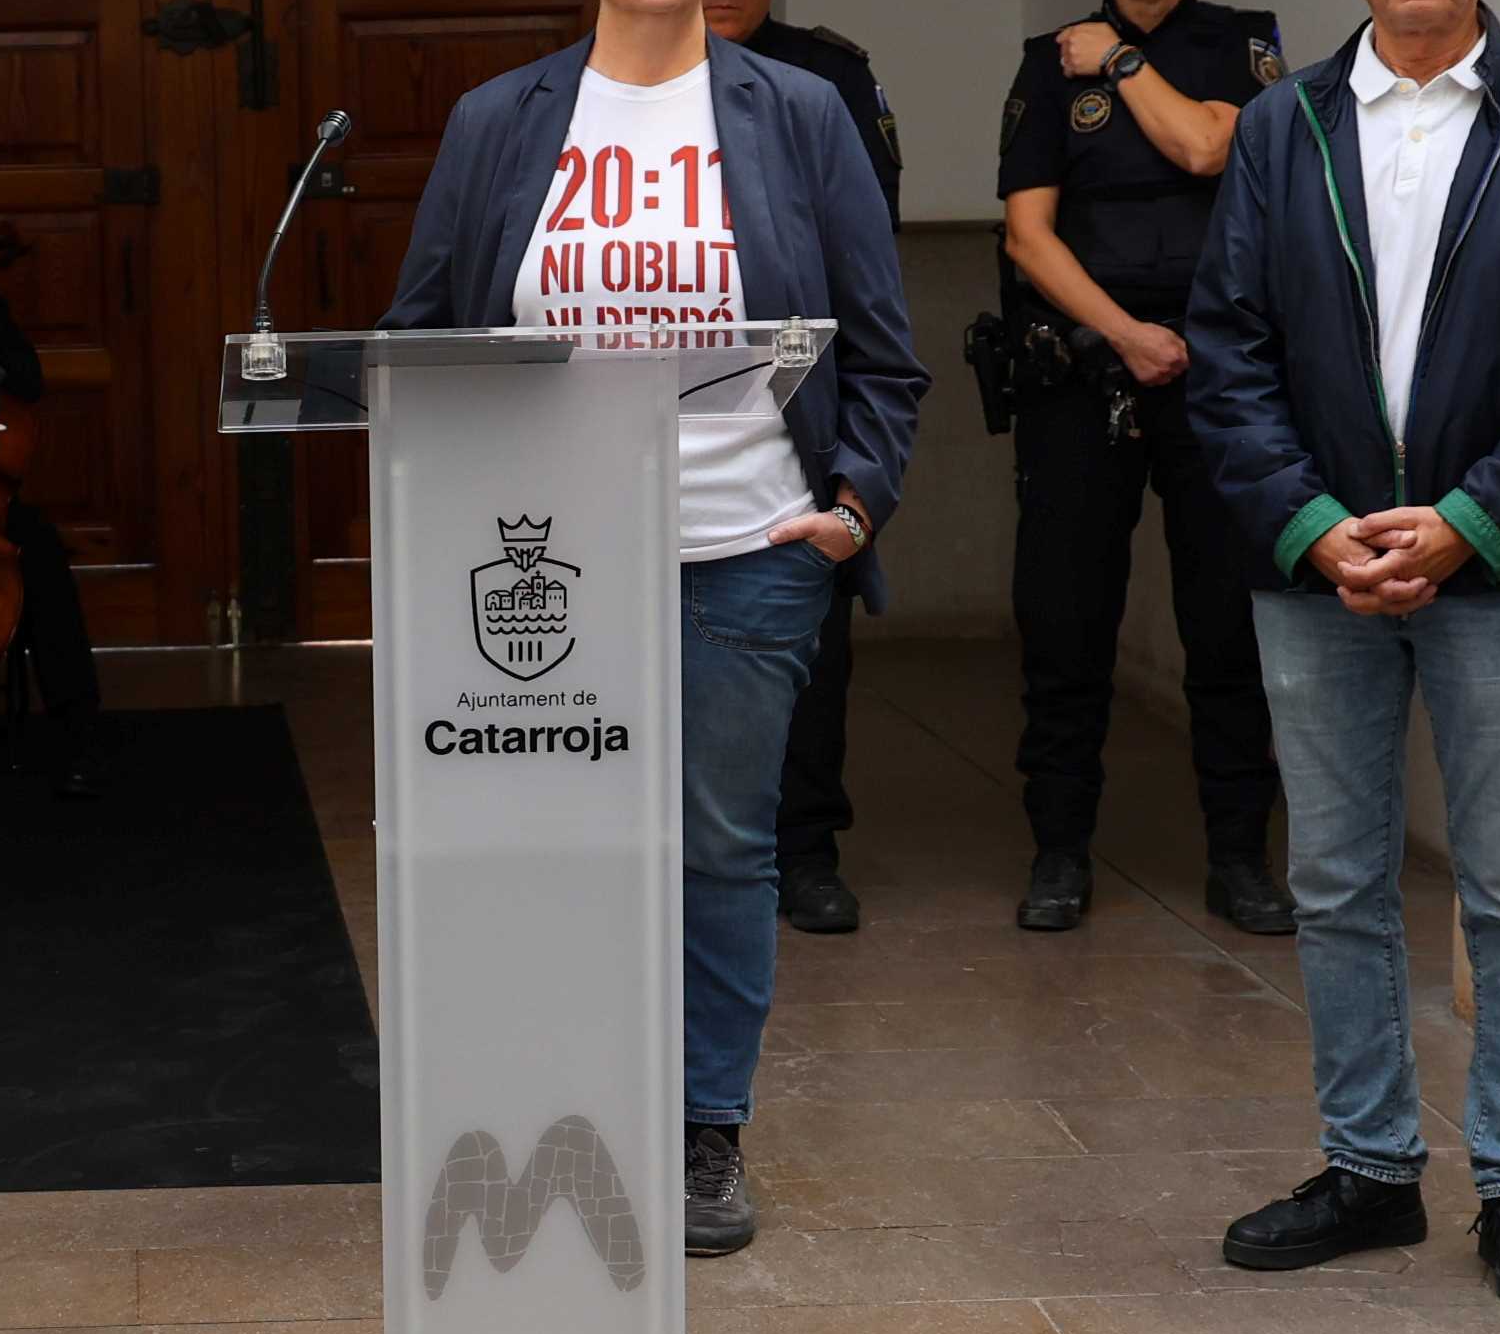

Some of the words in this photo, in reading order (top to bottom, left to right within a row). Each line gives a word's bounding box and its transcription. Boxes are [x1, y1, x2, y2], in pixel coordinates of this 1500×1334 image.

[540, 242, 585, 297] NI
[601, 240, 738, 294] OBLIT
[456, 691, 566, 712] Ajuntament
[572, 690, 598, 706] de
[424, 717, 630, 762] Catarroja
